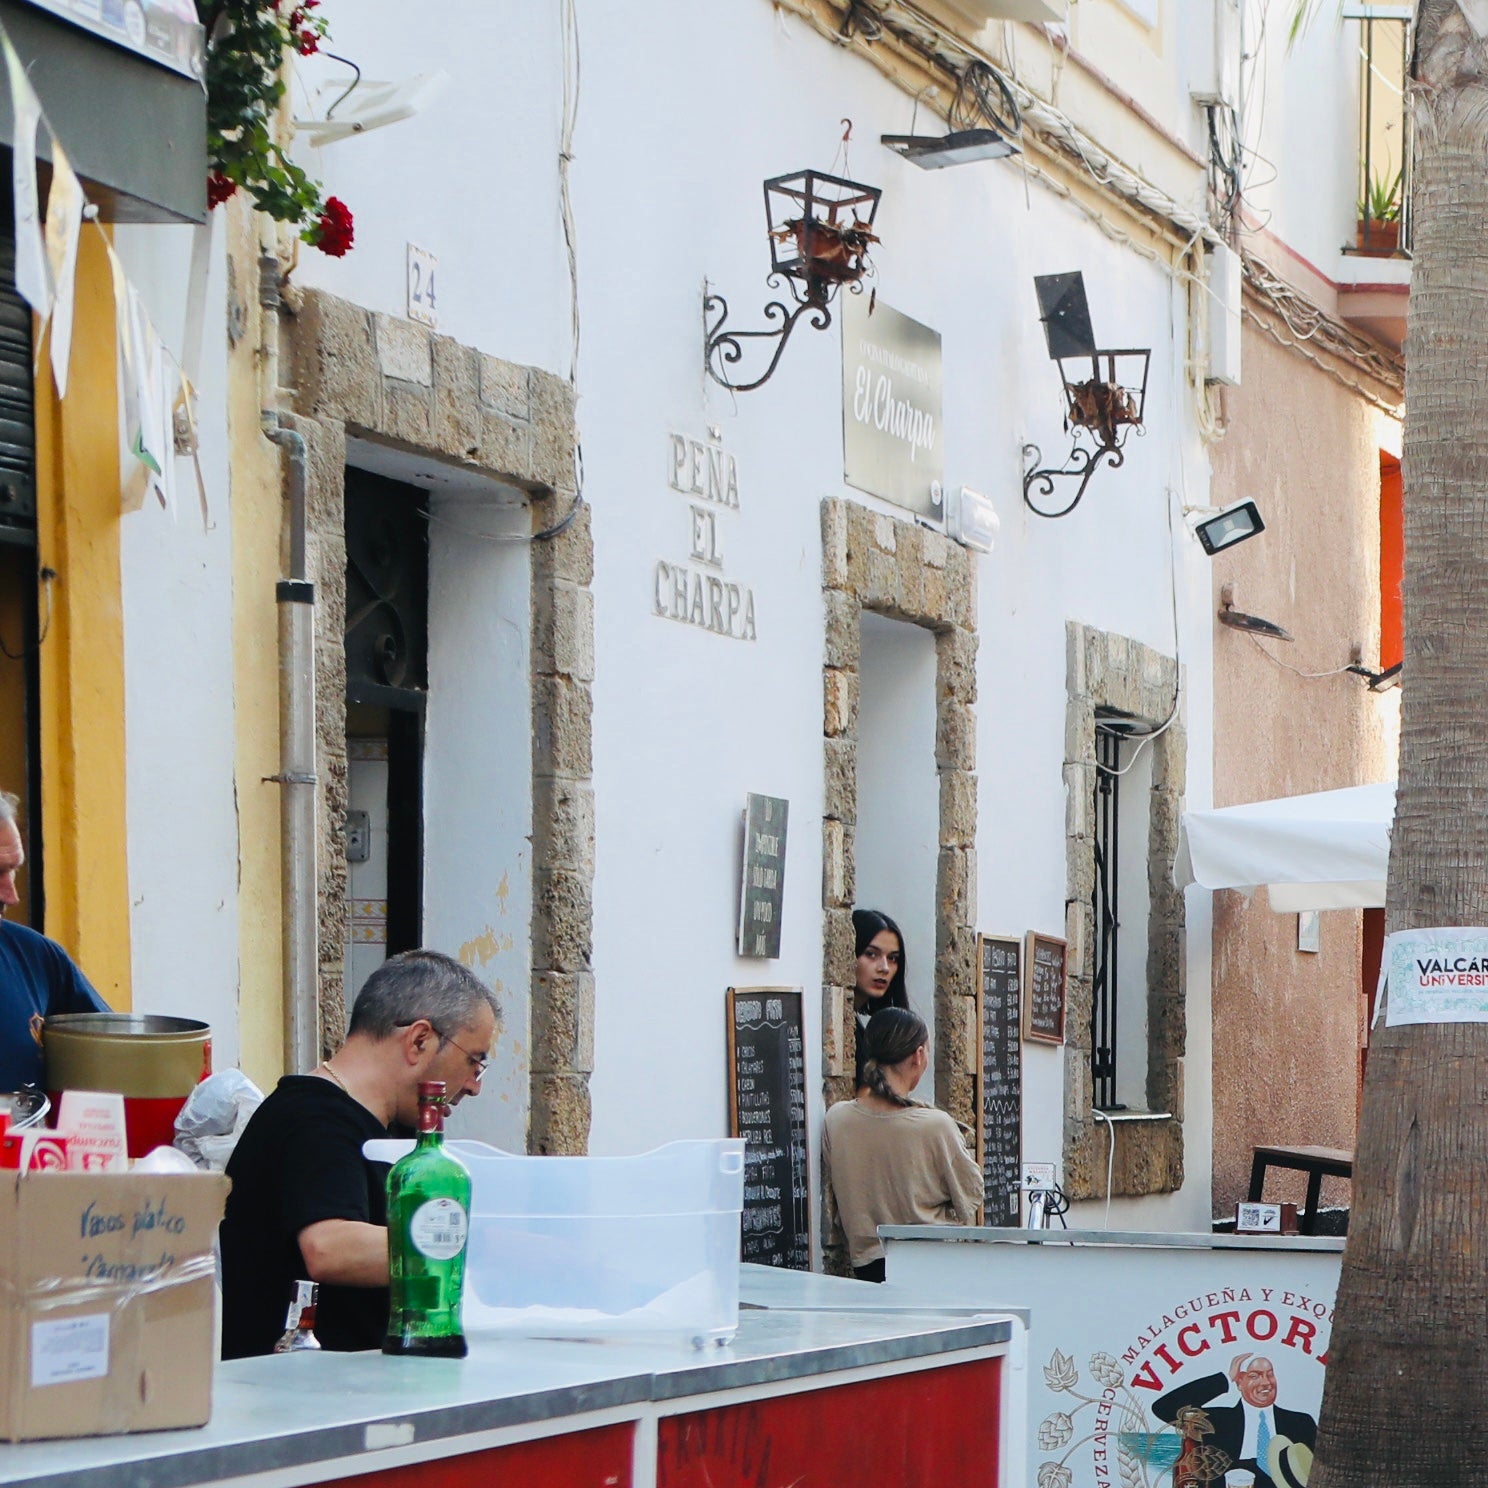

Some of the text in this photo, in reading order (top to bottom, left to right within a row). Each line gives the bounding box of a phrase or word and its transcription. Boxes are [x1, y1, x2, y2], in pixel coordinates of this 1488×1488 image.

[412, 261, 437, 310] 24
[854, 366, 935, 462] El Charpa
[669, 425, 740, 509] PEÑA
[690, 504, 723, 566] EL
[654, 560, 757, 641] CHARPA
[1121, 1287, 1252, 1365] MALAGUEÑA
[1260, 1288, 1274, 1301] Y
